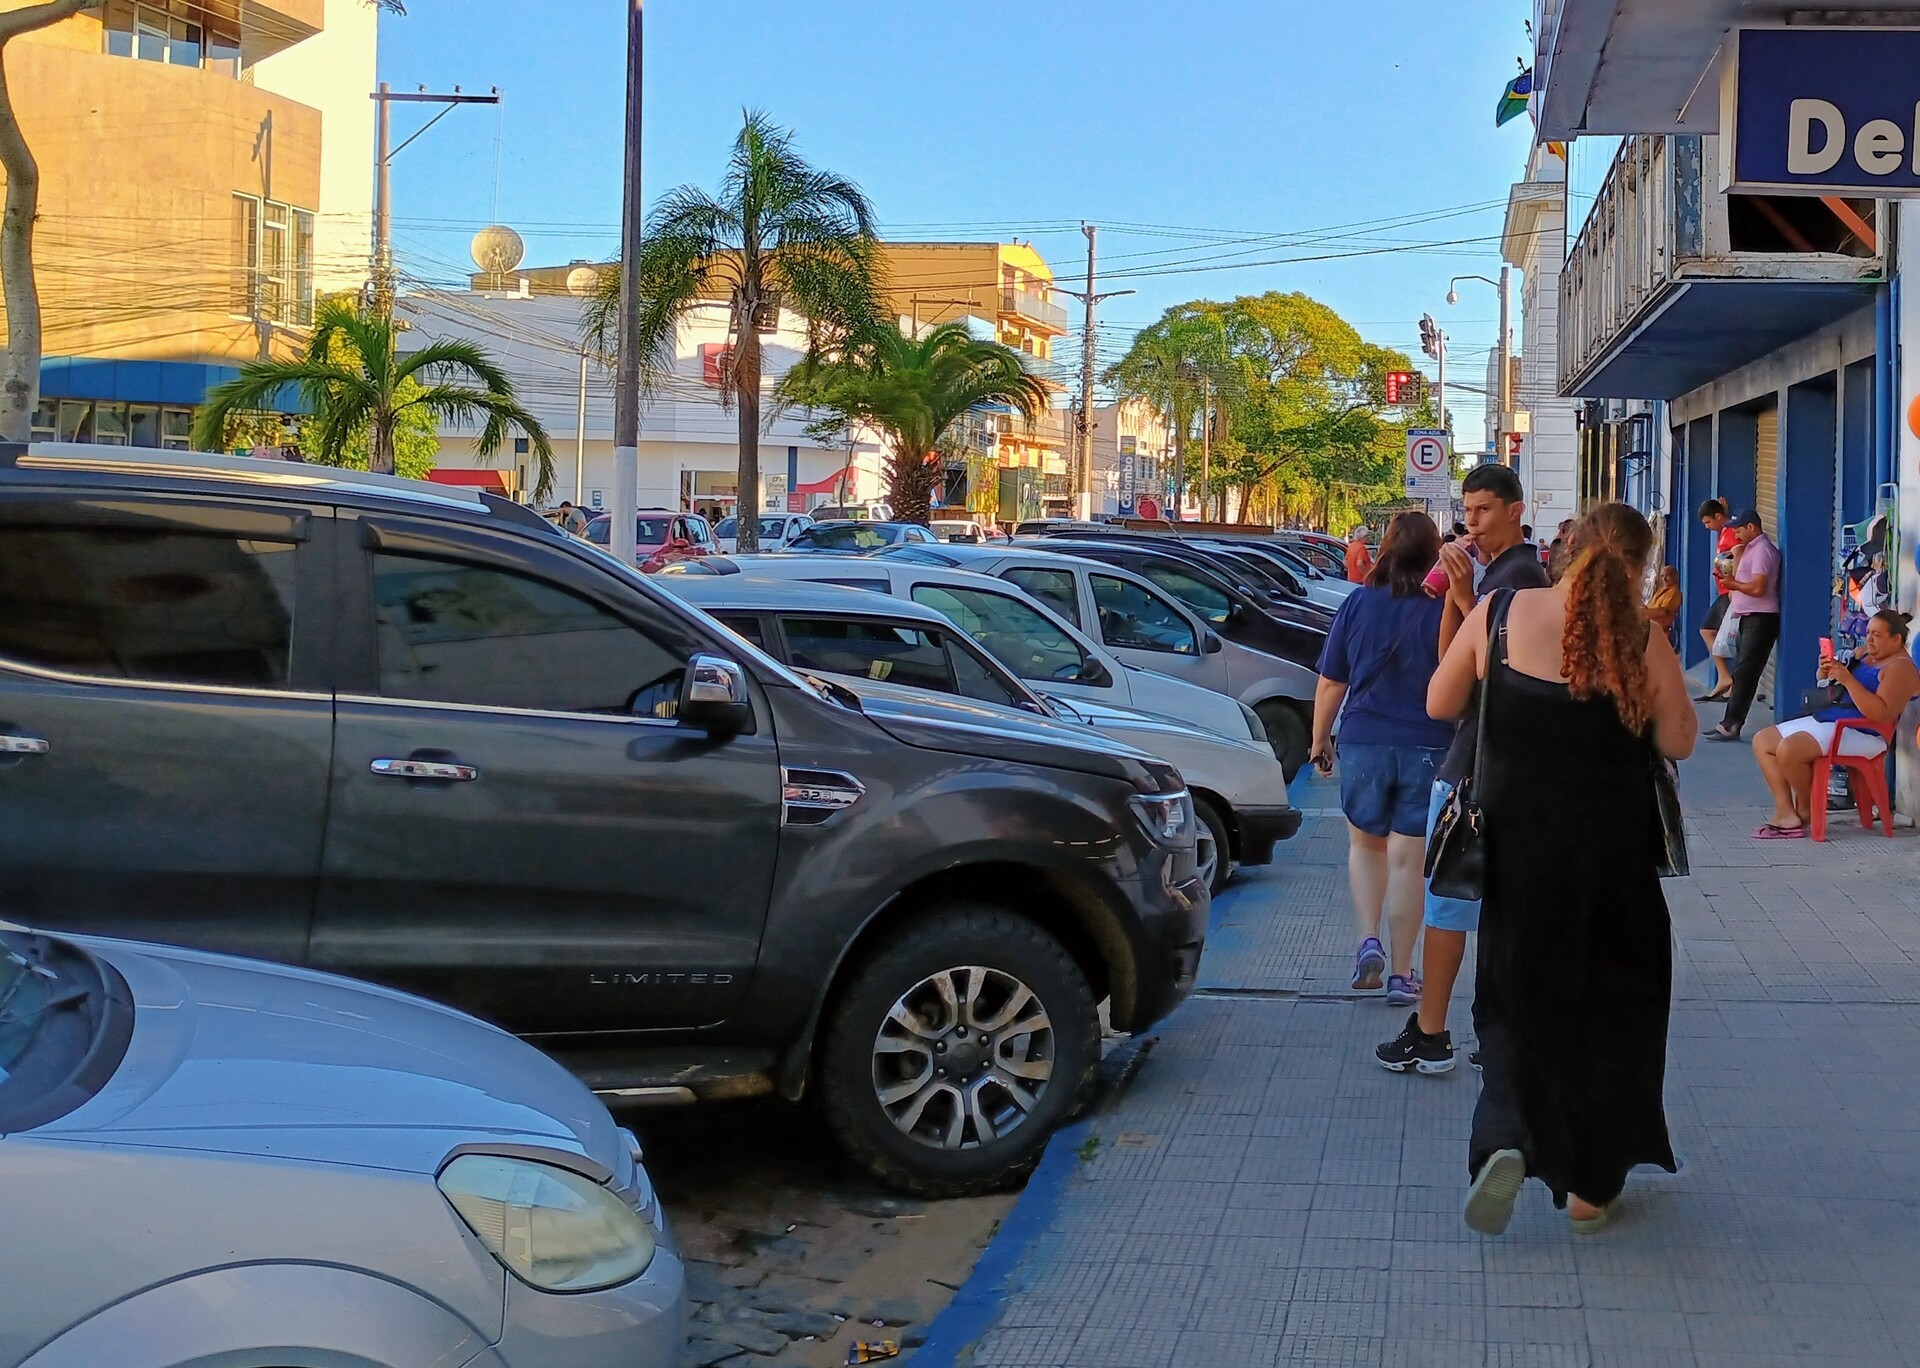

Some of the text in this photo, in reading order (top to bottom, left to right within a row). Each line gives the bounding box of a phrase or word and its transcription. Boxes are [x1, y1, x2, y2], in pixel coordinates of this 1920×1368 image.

[1421, 444, 1433, 465] E
[1121, 456, 1133, 509] Colombo
[589, 973, 733, 984] LIMITED
